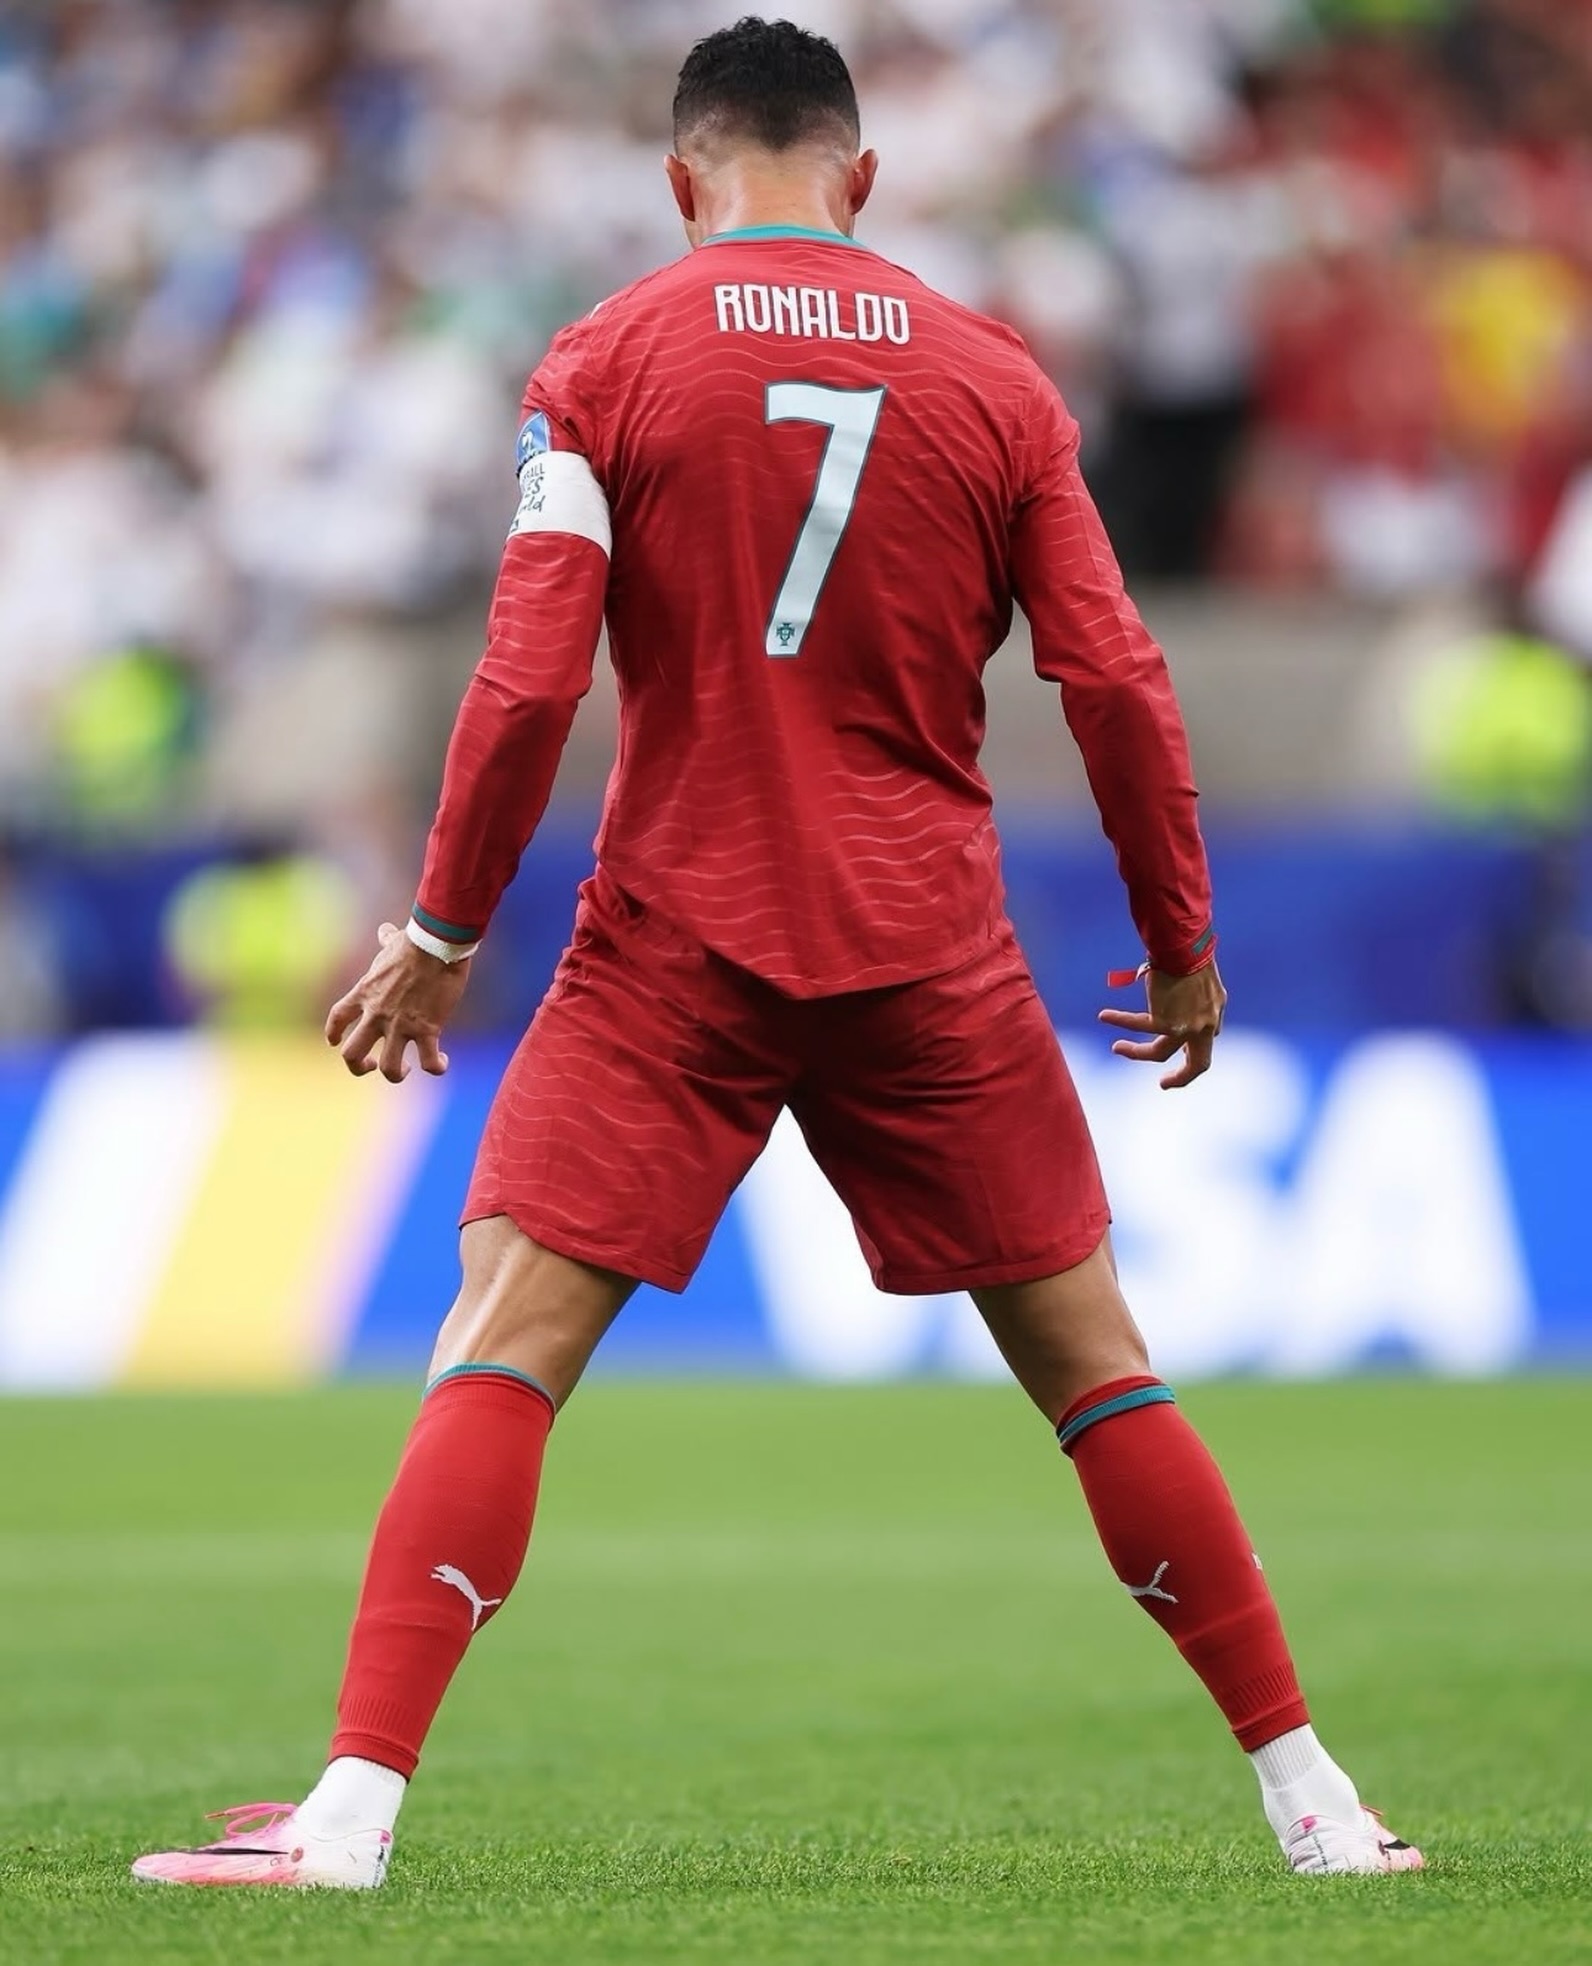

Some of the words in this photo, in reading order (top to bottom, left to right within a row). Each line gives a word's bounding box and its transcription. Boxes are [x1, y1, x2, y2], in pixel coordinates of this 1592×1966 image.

[714, 284, 911, 344] RONALDO
[765, 382, 887, 658] 7
[735, 1029, 1537, 1380] VSA
